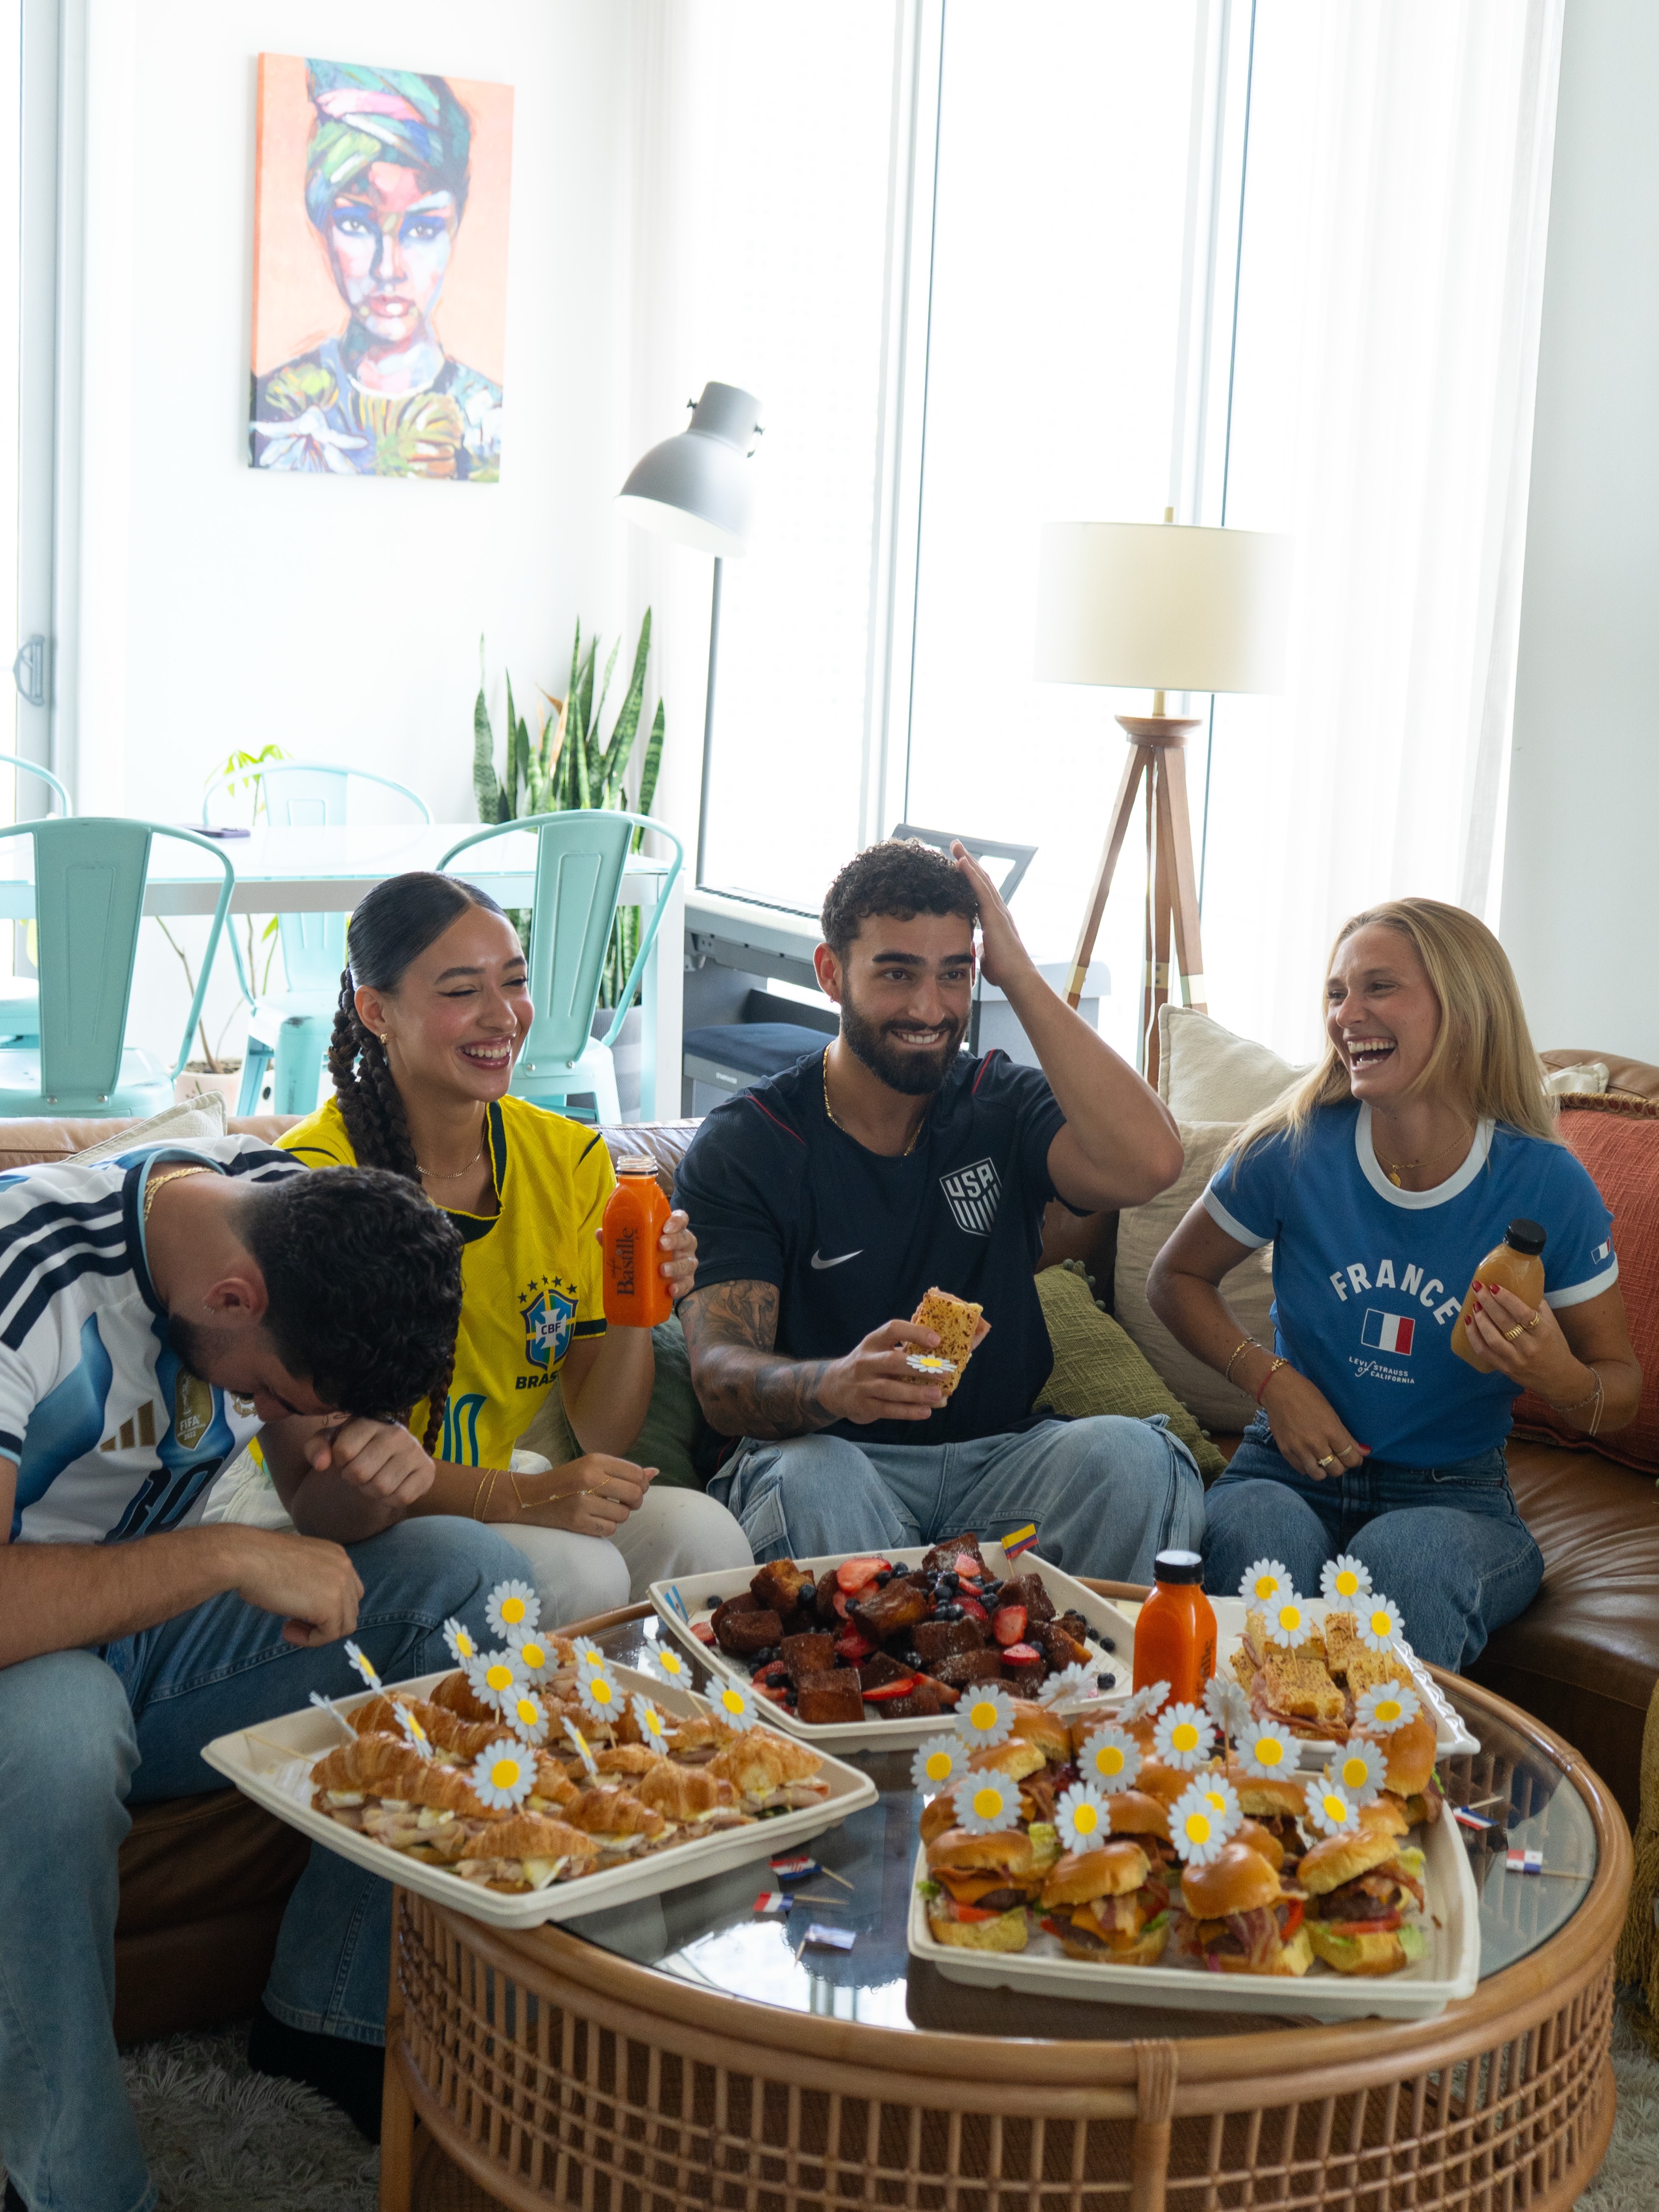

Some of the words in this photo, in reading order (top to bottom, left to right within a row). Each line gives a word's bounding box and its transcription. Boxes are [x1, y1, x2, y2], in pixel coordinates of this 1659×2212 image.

[945, 1163, 994, 1198] USA
[616, 1227, 634, 1297] Bastille
[1329, 1259, 1462, 1325] FRANCE
[541, 1321, 562, 1336] CBF
[1348, 1356, 1367, 1367] LEVI
[1373, 1364, 1408, 1377] STRAUSS
[1354, 1360, 1376, 1377] of
[1371, 1371, 1415, 1384] CALIFORNIA
[180, 1415, 199, 1432] FIFA
